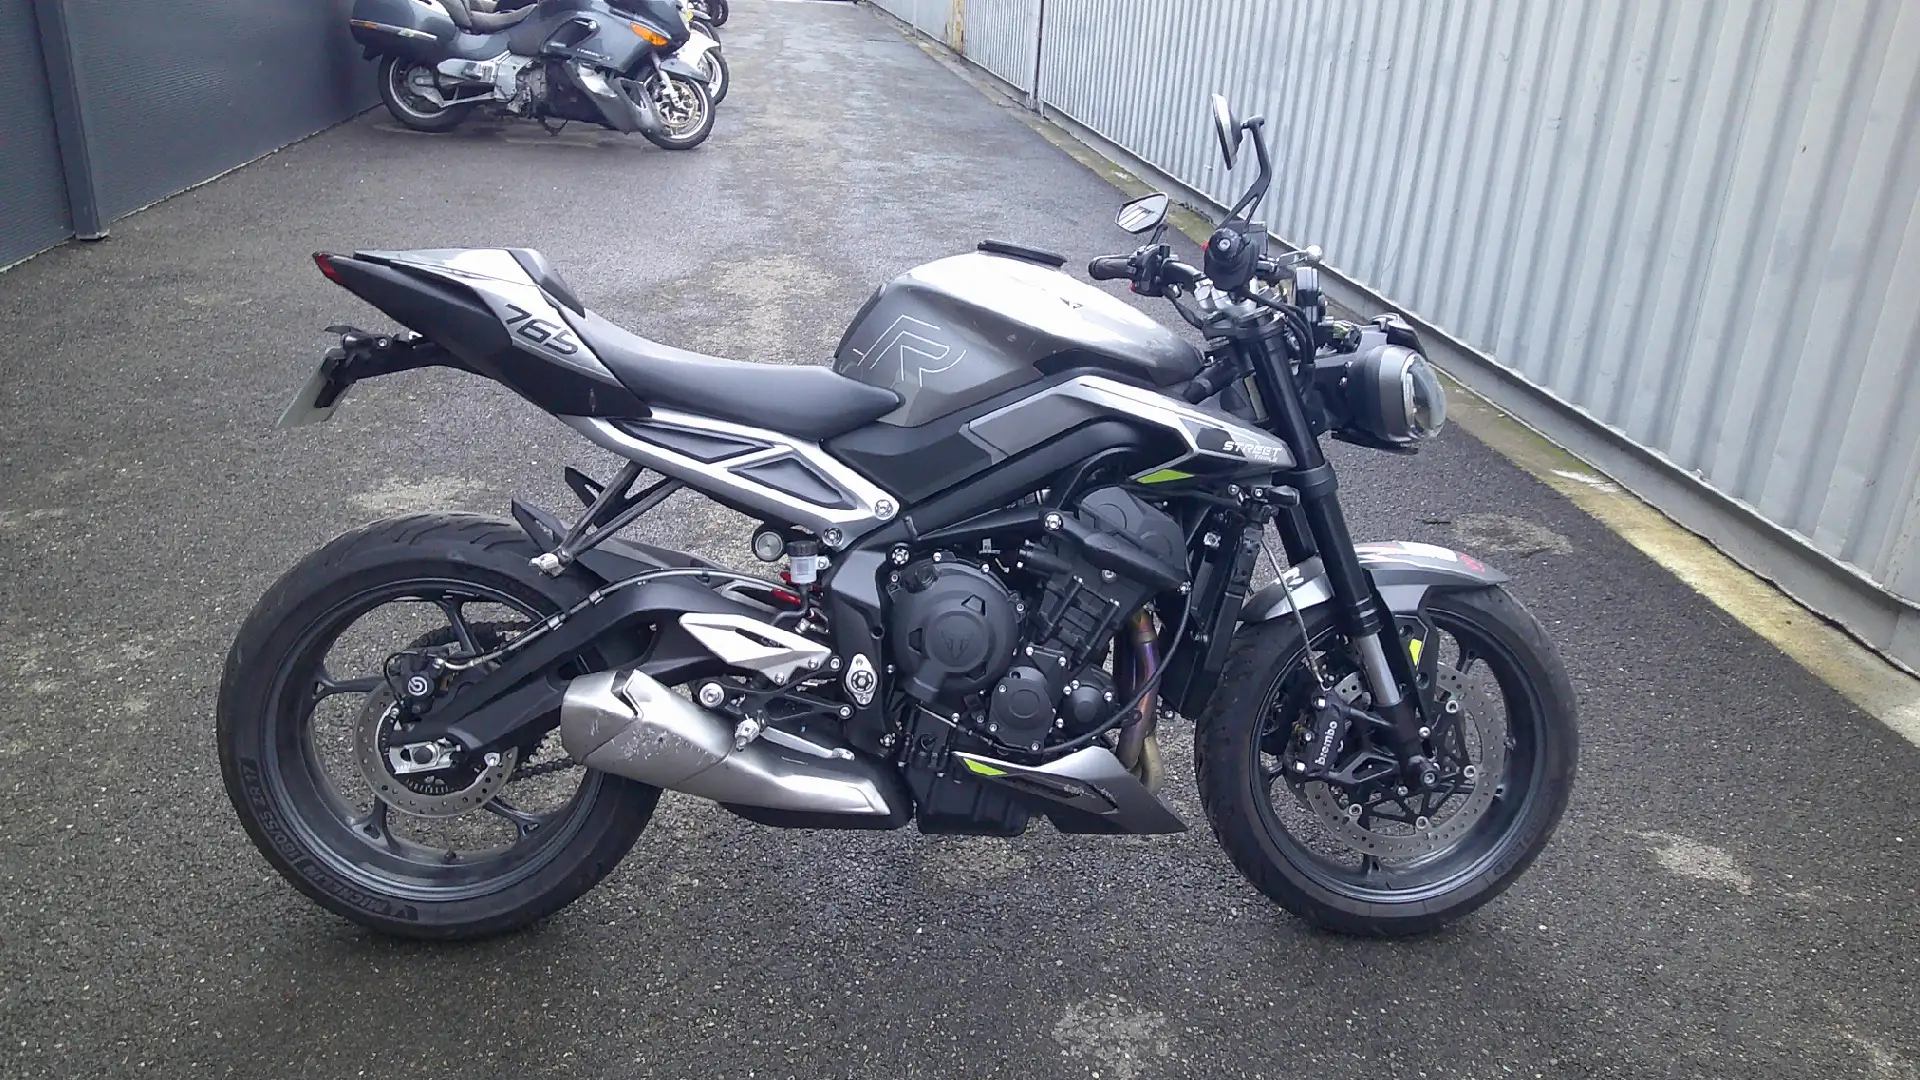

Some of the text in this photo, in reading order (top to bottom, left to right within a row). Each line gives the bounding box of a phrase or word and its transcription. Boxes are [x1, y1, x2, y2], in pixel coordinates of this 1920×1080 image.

[505, 303, 579, 355] 765
[1222, 440, 1282, 457] STREET
[1314, 720, 1338, 767] brembo
[303, 864, 389, 912] MICHELIN
